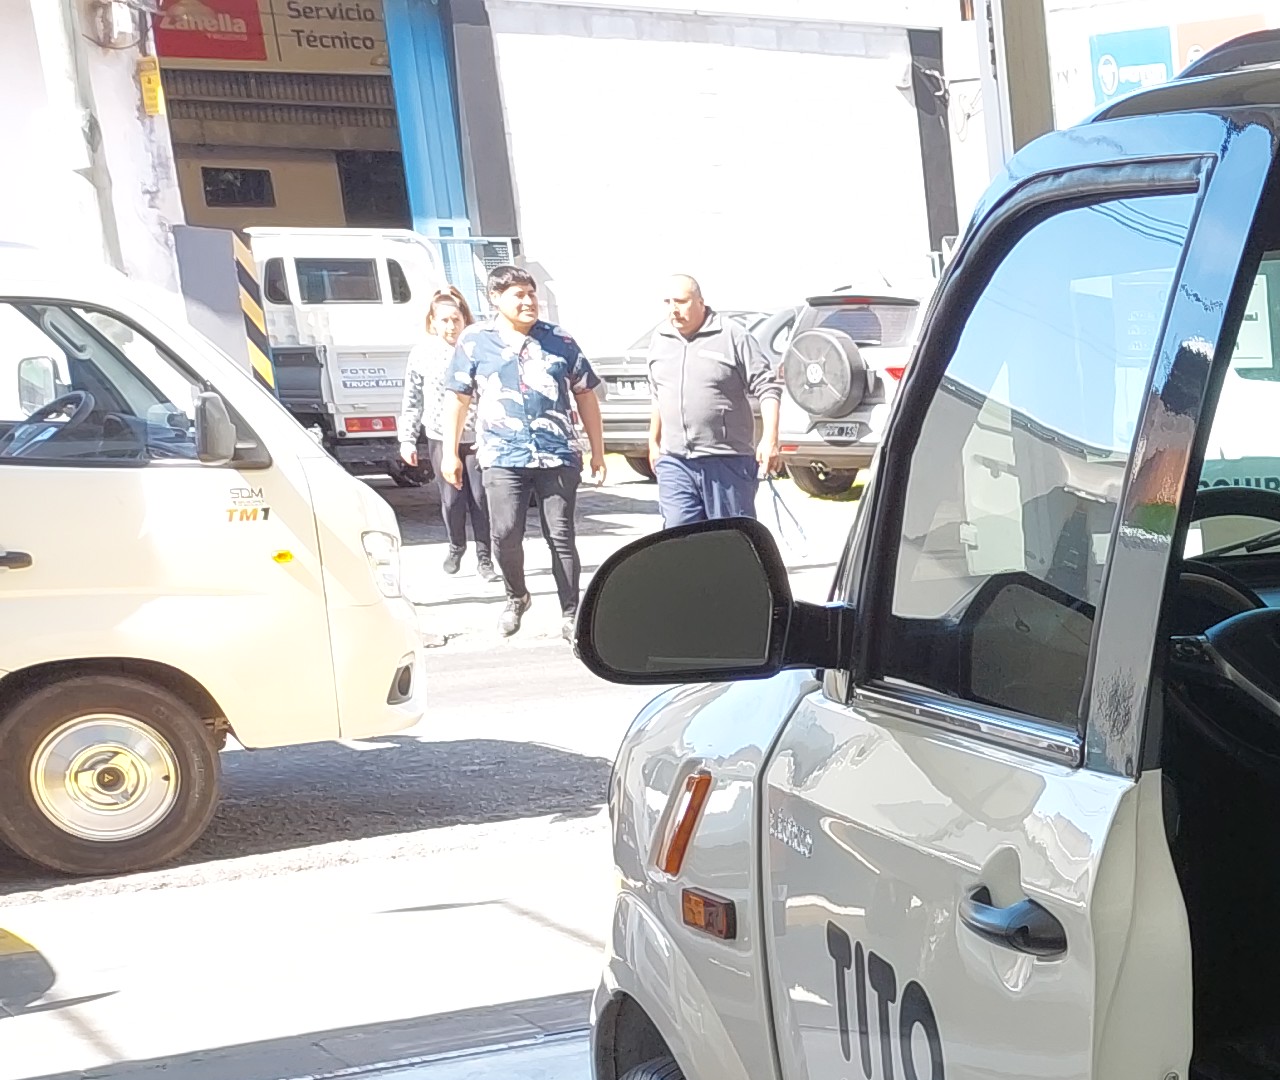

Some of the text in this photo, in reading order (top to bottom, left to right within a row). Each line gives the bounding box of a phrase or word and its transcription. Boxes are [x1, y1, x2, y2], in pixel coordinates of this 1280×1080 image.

[287, 1, 375, 21] Servicio
[290, 29, 375, 50] Técnico
[345, 379, 403, 388] TRUCK MATE
[226, 507, 271, 522] TM1
